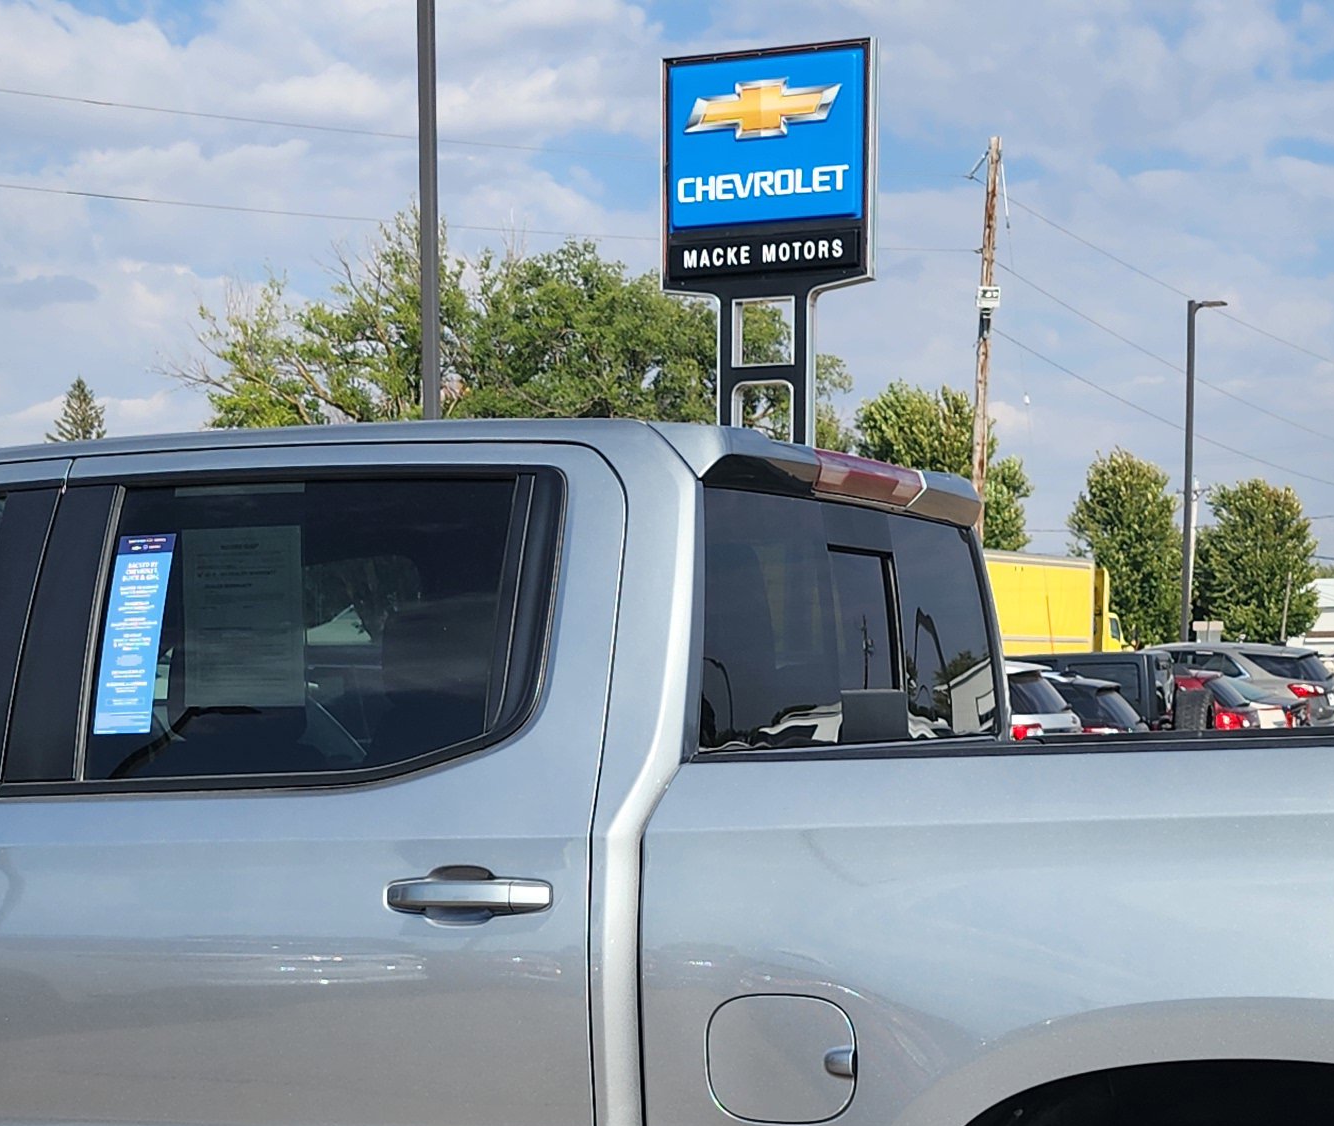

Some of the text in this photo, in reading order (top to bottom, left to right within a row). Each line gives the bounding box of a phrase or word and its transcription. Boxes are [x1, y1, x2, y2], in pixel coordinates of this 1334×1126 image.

[677, 164, 850, 204] CHEVROLET
[683, 239, 844, 269] MACKE MOTORS
